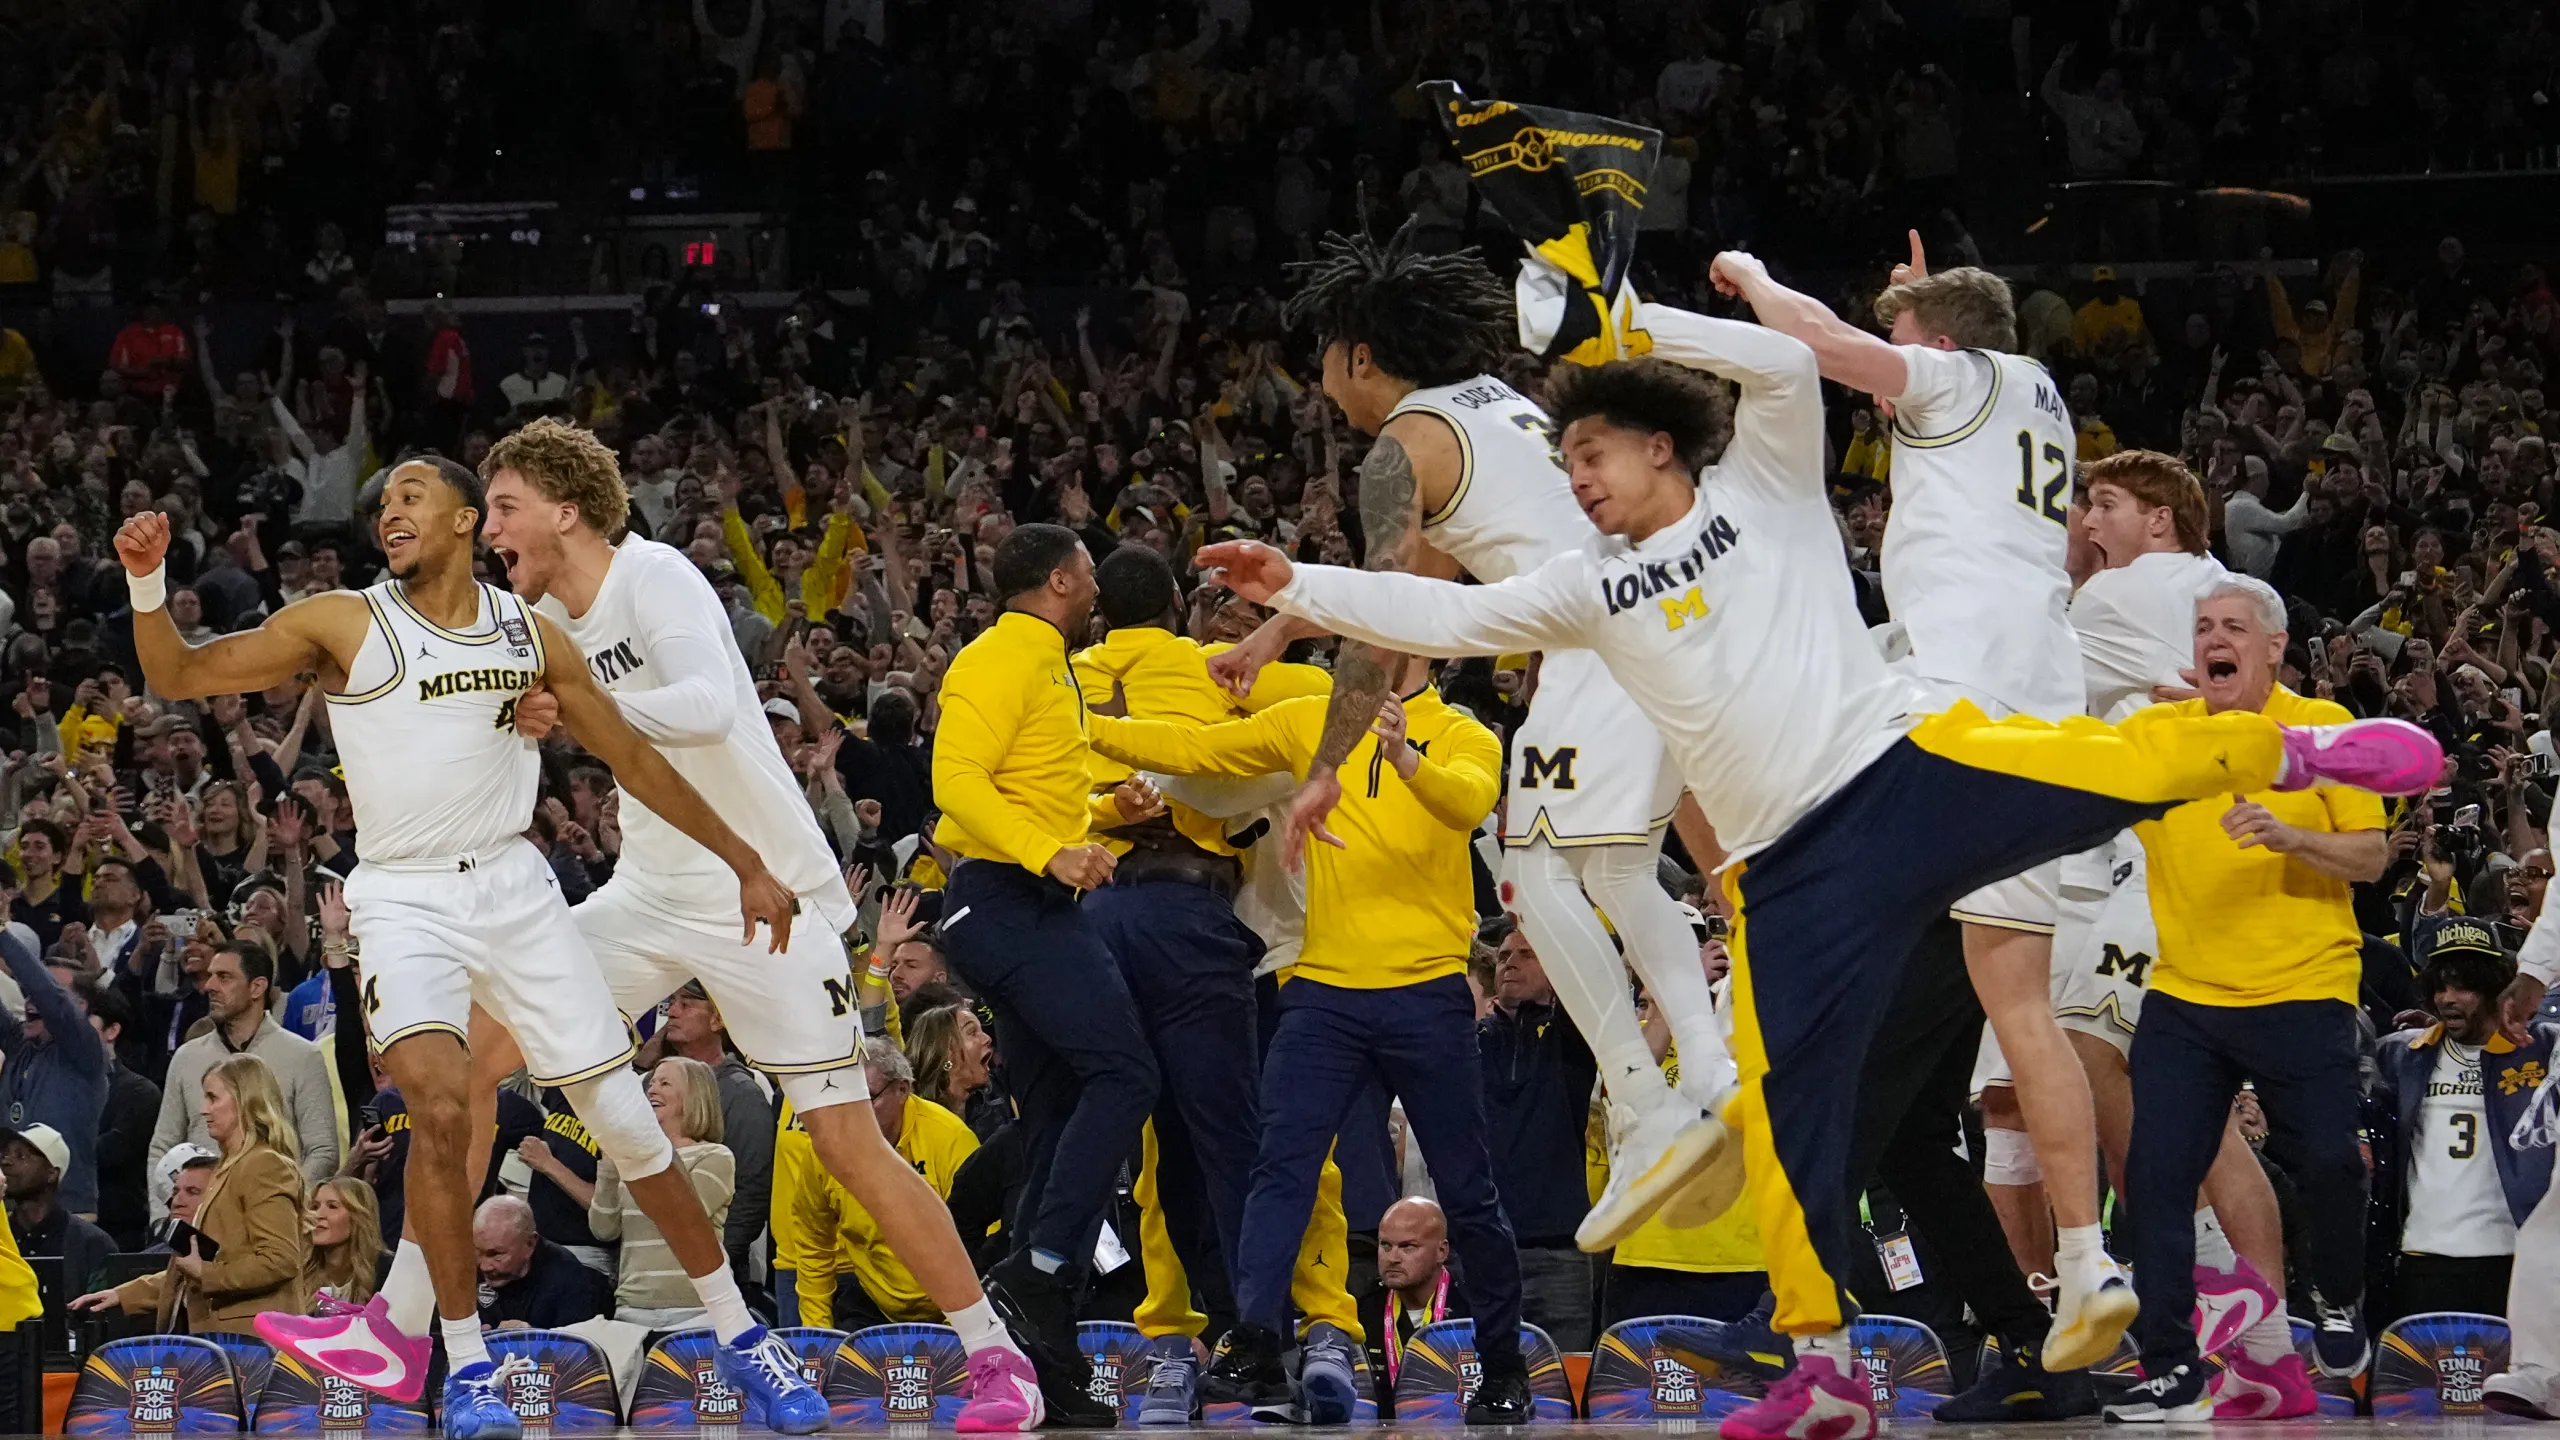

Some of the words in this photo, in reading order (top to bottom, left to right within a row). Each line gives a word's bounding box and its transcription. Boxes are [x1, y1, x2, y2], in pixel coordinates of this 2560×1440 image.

[1452, 385, 1521, 409] CADEAU
[2017, 429, 2068, 528] 12
[1659, 585, 1711, 631] M
[1520, 746, 1578, 789] M
[2436, 922, 2491, 948] Michigan
[2095, 943, 2151, 988] M
[823, 974, 859, 1017] M
[2449, 1113, 2476, 1159] 3
[2438, 1358, 2482, 1372] FINAL
[511, 1373, 552, 1387] FINAL
[887, 1367, 928, 1381] FINAL
[135, 1377, 176, 1392] FINAL
[1657, 1388, 1697, 1402] FOUR
[2442, 1388, 2482, 1402] FOUR
[512, 1403, 550, 1417] FOUR
[700, 1399, 738, 1413] FOUR
[889, 1396, 928, 1410] FOUR
[134, 1407, 174, 1421] FOUR
[324, 1404, 363, 1418] FOUR
